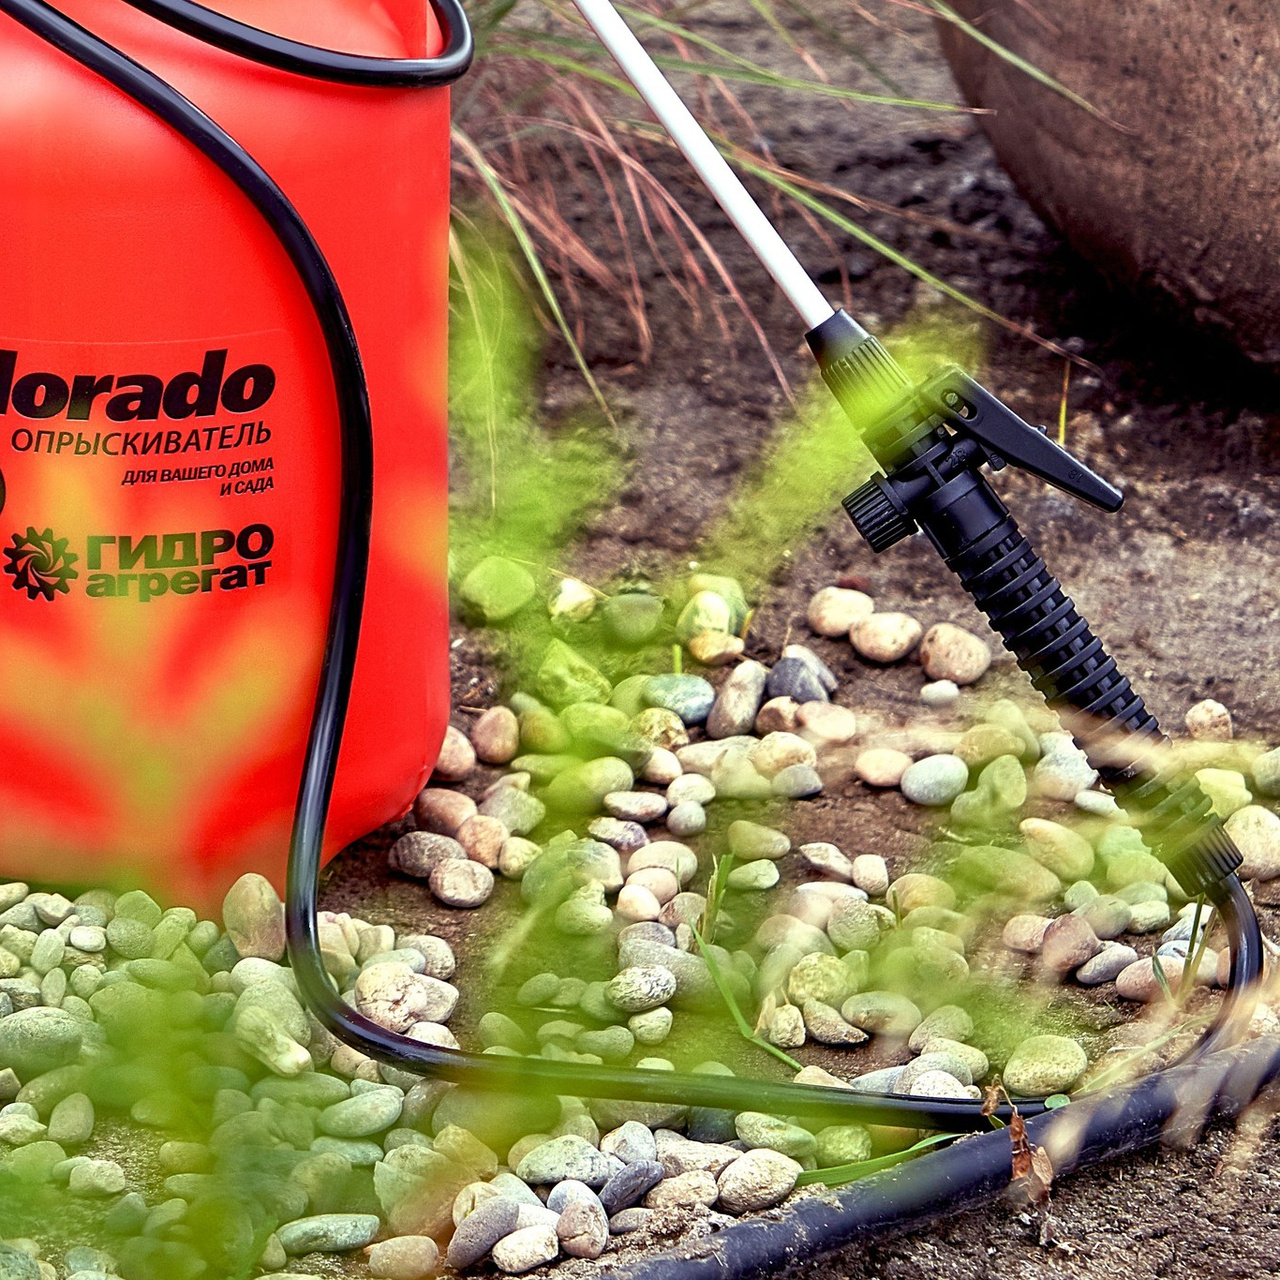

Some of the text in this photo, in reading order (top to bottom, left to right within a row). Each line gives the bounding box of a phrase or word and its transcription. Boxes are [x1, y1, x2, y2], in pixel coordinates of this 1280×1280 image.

[11, 420, 272, 456] ОПРЫСКИВАТЕЛЬ
[121, 457, 275, 486] ДЛЯ ВАШЕГО ДОМА
[220, 476, 275, 497] И САДА
[86, 523, 275, 570] ГИДРО
[85, 560, 273, 603] агрегат
